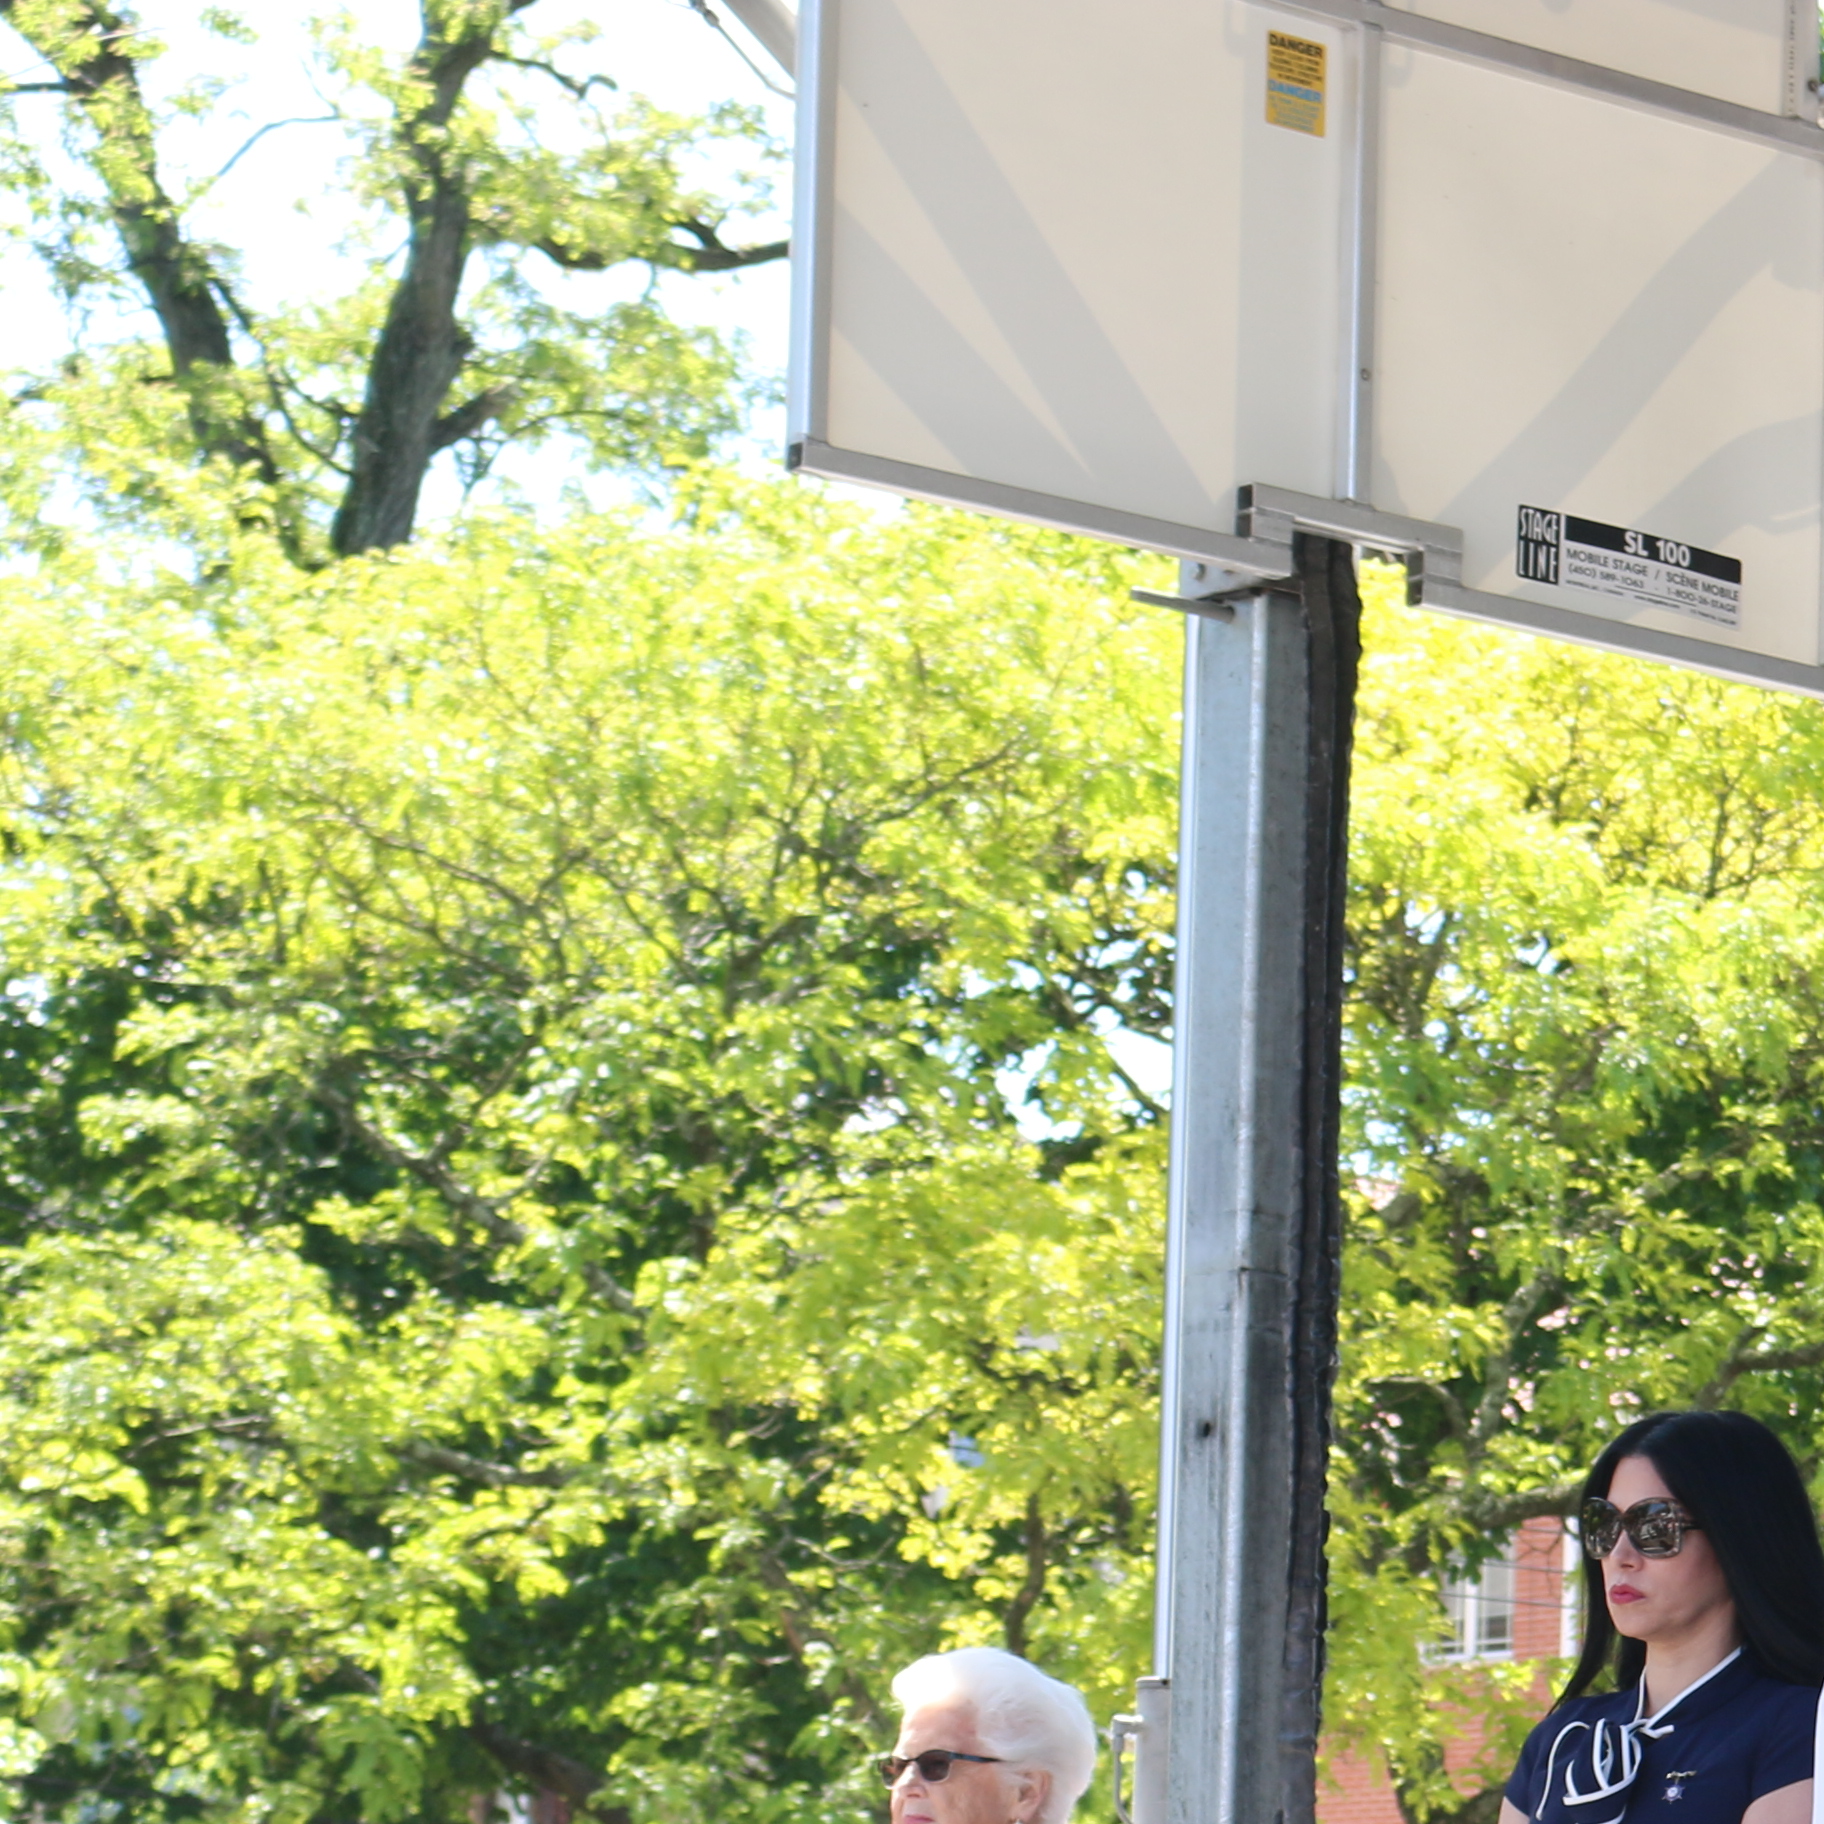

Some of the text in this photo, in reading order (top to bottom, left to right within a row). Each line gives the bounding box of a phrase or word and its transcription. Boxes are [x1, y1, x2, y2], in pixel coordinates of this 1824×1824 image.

[1519, 508, 1558, 545] STAGE
[1519, 539, 1557, 583] LINE
[1624, 531, 1691, 567] SL 100
[1566, 548, 1609, 567] MOBILE
[1613, 558, 1648, 577] STAGE
[1701, 582, 1739, 601] MOBILE
